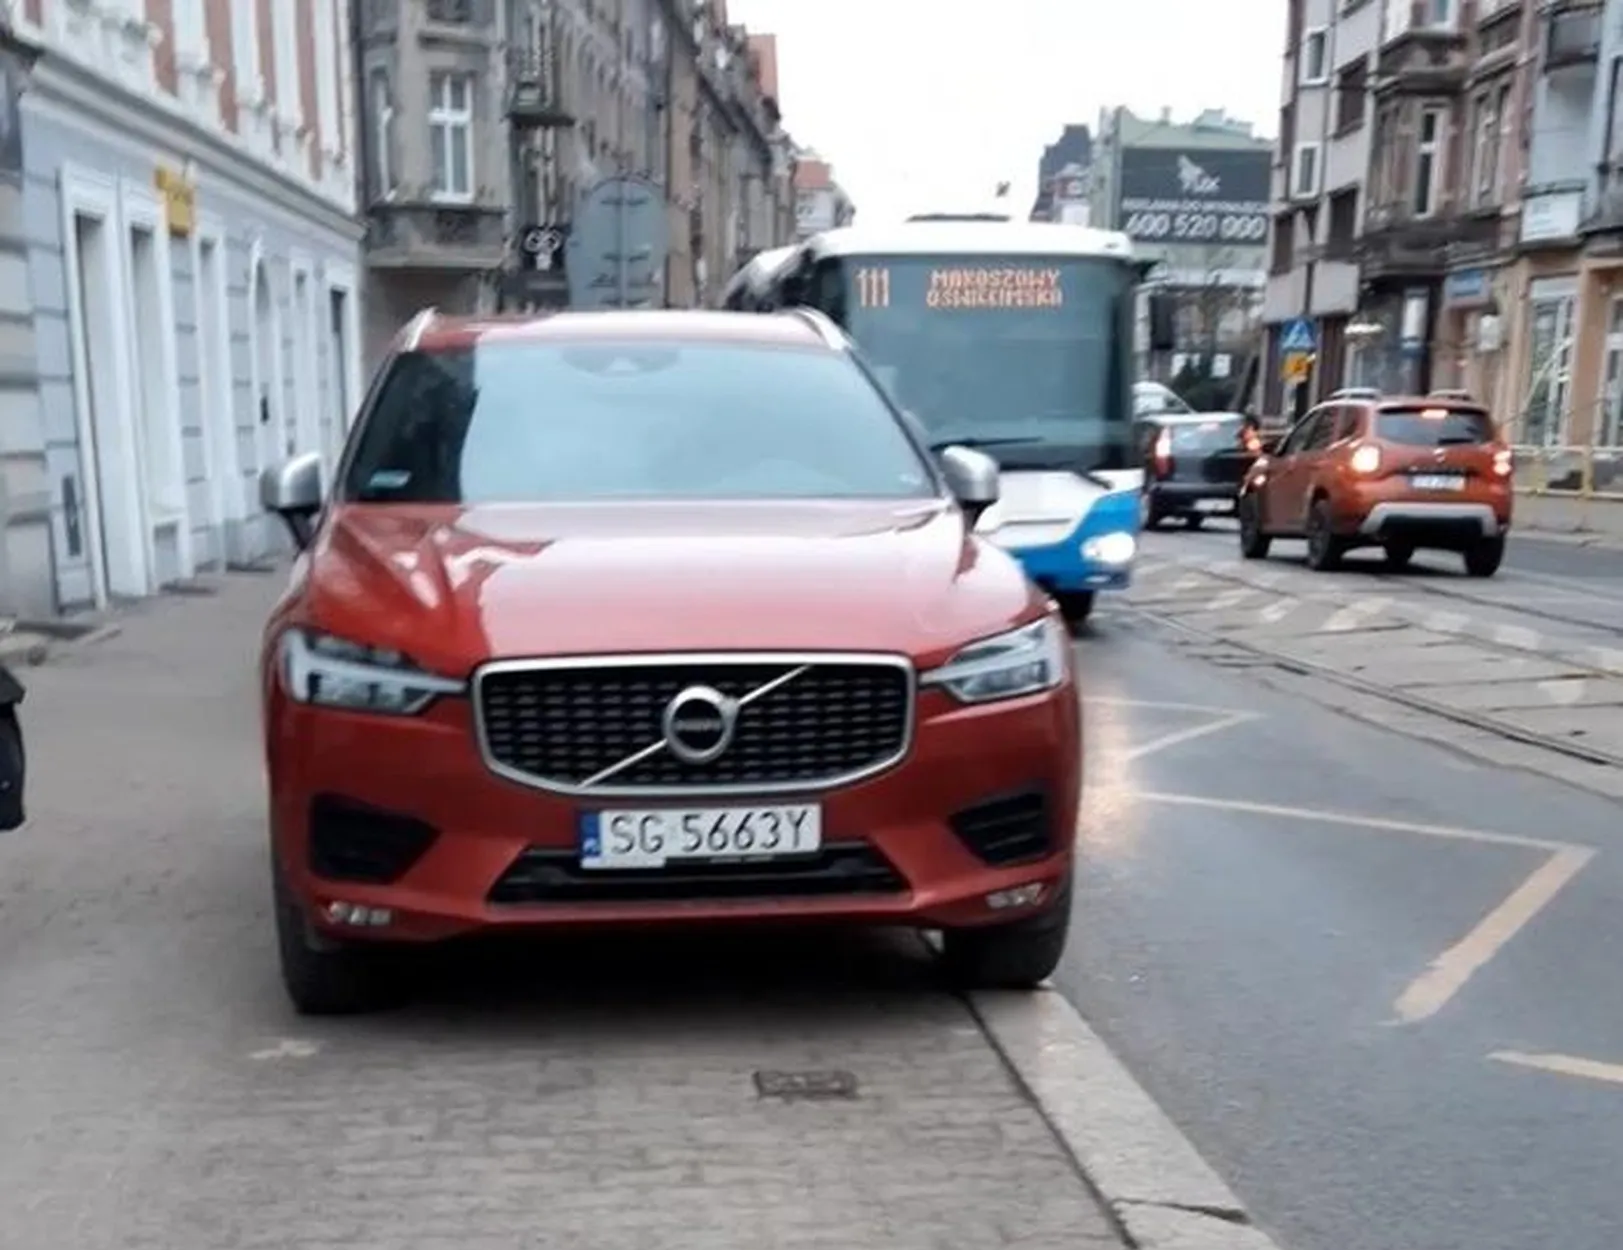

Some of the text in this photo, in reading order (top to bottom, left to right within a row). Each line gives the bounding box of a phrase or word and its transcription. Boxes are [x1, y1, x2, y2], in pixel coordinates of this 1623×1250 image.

[1174, 214, 1218, 238] 520
[857, 268, 890, 307] 111
[610, 814, 664, 854] SG
[681, 809, 808, 852] 5663Y
